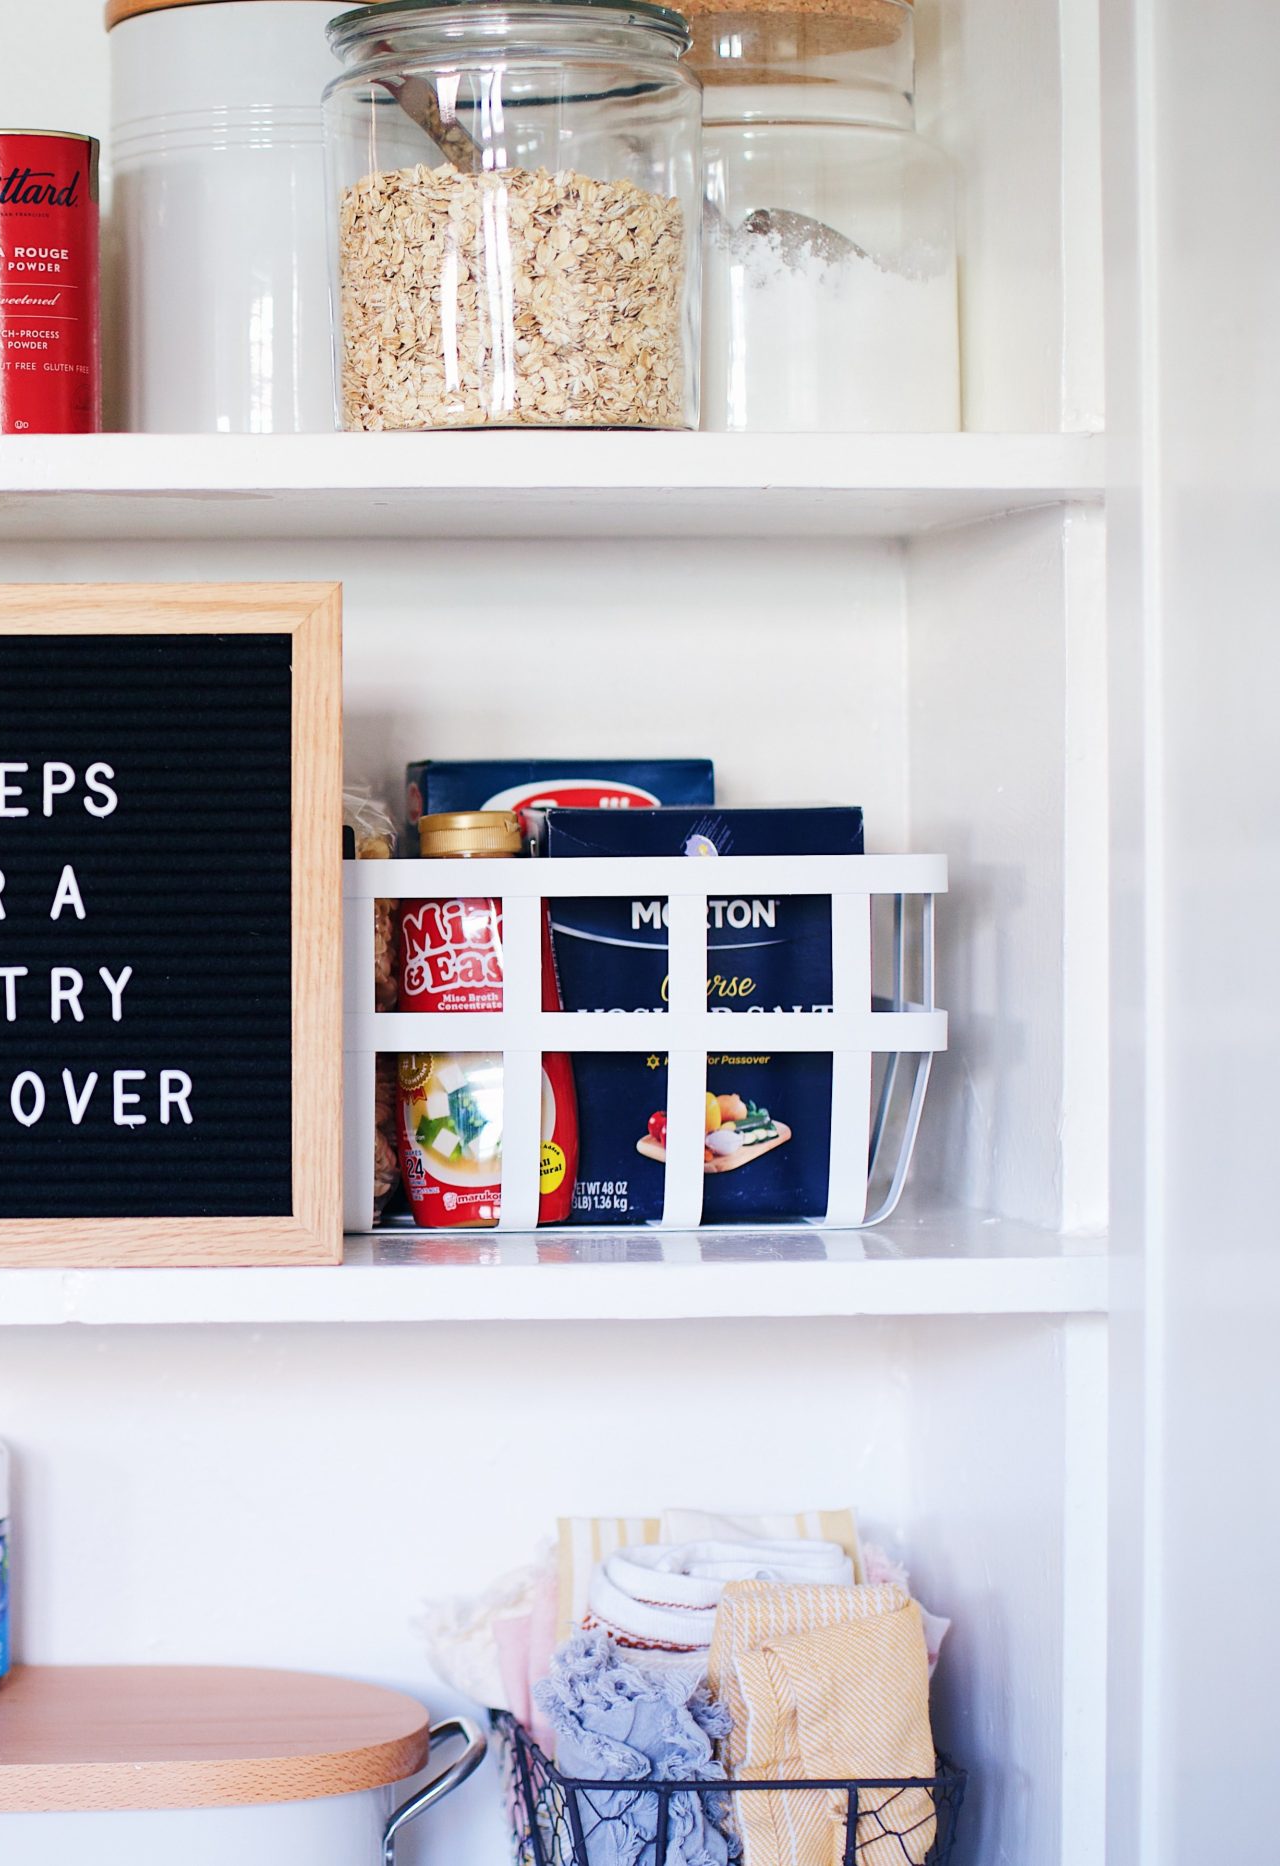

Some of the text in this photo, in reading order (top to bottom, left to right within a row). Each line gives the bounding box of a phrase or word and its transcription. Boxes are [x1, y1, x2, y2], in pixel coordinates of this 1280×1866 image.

[15, 247, 69, 260] ROUGE
[8, 262, 61, 273] POWDER
[8, 341, 48, 350] POWDER
[15, 362, 37, 371] FREE
[43, 363, 74, 372] GLUTEN
[76, 364, 89, 374] FREE
[50, 864, 86, 920] A
[631, 900, 776, 930] MTON
[442, 992, 499, 1002] Miso Broth
[438, 1001, 503, 1011] Concentrate
[721, 1055, 771, 1065] Passover
[406, 1157, 425, 1179] 24
[586, 1181, 600, 1195] WT
[601, 1181, 614, 1195] 48
[615, 1181, 628, 1195] OZ
[593, 1196, 612, 1209] 1.36
[613, 1195, 628, 1212] kg
